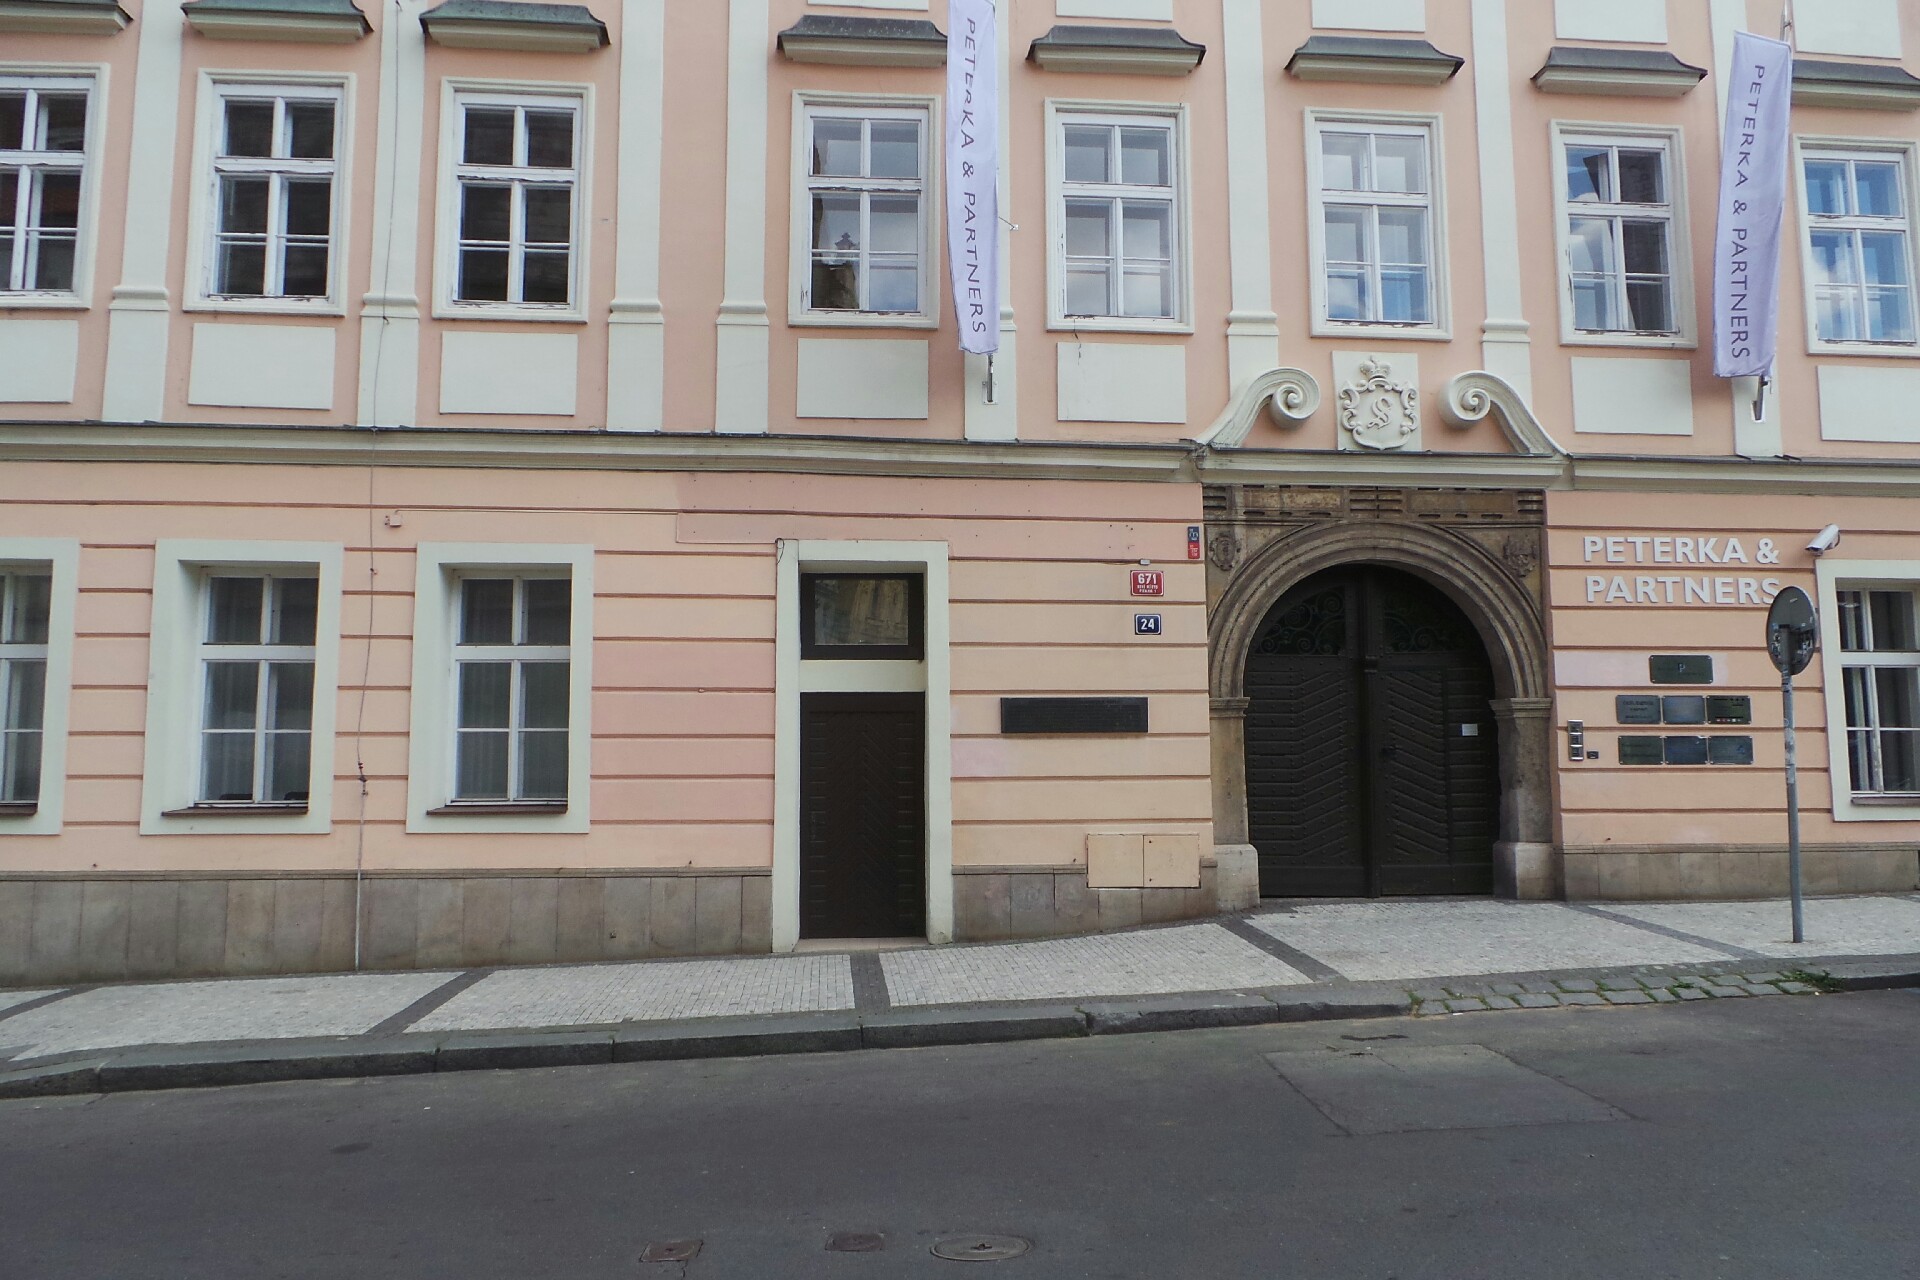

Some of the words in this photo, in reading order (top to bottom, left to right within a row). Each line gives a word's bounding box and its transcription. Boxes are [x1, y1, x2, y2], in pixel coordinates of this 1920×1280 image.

[960, 18, 977, 148] PETERKA
[1735, 64, 1765, 187] PETERKA
[962, 160, 975, 178] &
[1732, 199, 1748, 215] &
[963, 191, 987, 333] PARTNERS
[1730, 227, 1750, 358] PARTNERS
[1584, 536, 1748, 564] PETERKA
[1756, 538, 1780, 564] &
[1138, 573, 1157, 584] 671
[1586, 575, 1780, 604] PARTNERS
[1140, 618, 1155, 630] 24
